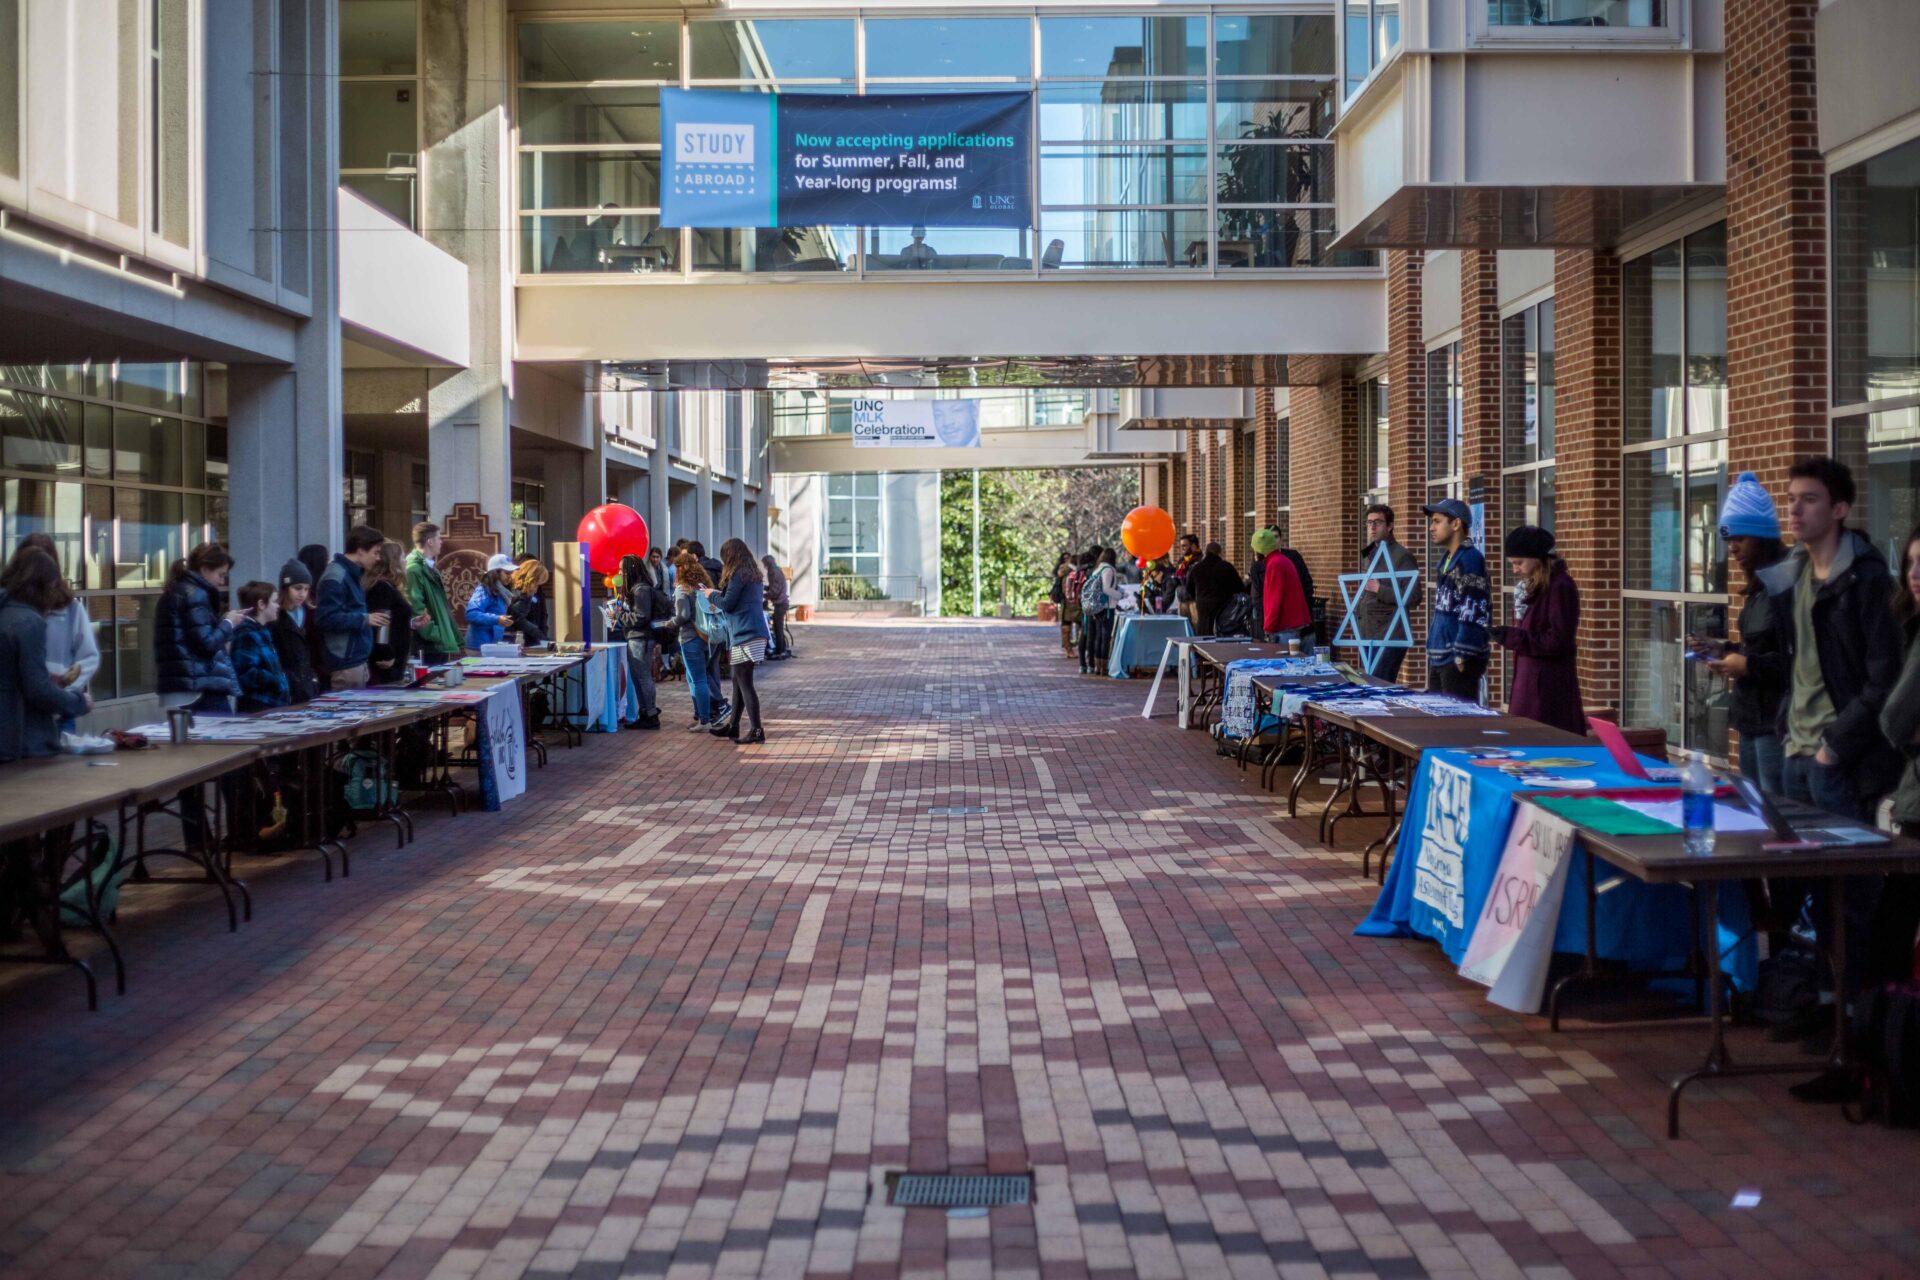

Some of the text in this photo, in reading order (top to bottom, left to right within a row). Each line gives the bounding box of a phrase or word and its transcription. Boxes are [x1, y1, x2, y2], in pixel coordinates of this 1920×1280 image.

[684, 133, 746, 154] STUDY
[795, 132, 1014, 149] Now accepting applications
[795, 155, 965, 170] for Summer, Fall, and
[684, 174, 745, 185] ABROAD
[795, 176, 957, 193] Year-long programs!
[990, 195, 1015, 204] UNC
[854, 400, 884, 411] UNC
[854, 412, 884, 422] MLK
[854, 424, 925, 435] Celebration
